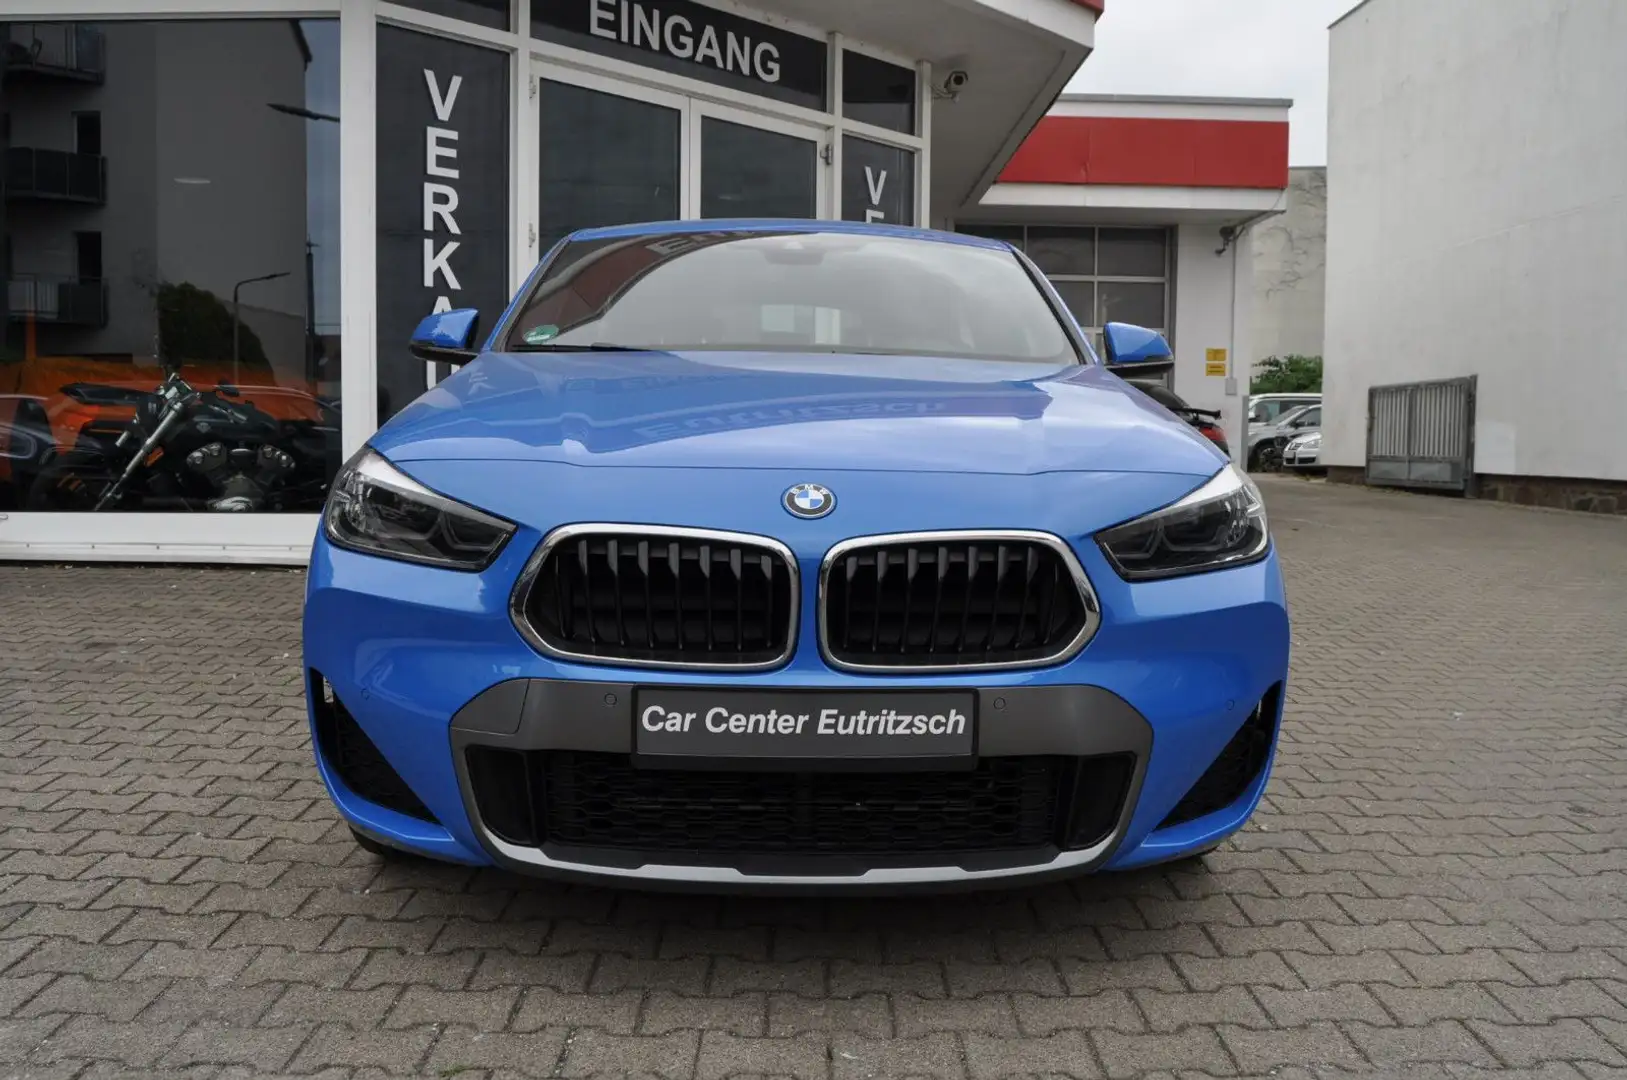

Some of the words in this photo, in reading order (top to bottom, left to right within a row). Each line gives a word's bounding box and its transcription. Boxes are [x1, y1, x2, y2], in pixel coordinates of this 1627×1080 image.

[590, 0, 780, 82] EINGANG
[790, 484, 829, 495] BMW
[642, 706, 696, 732] Car
[705, 707, 809, 734] Center
[817, 709, 966, 735] Eutritzsch
